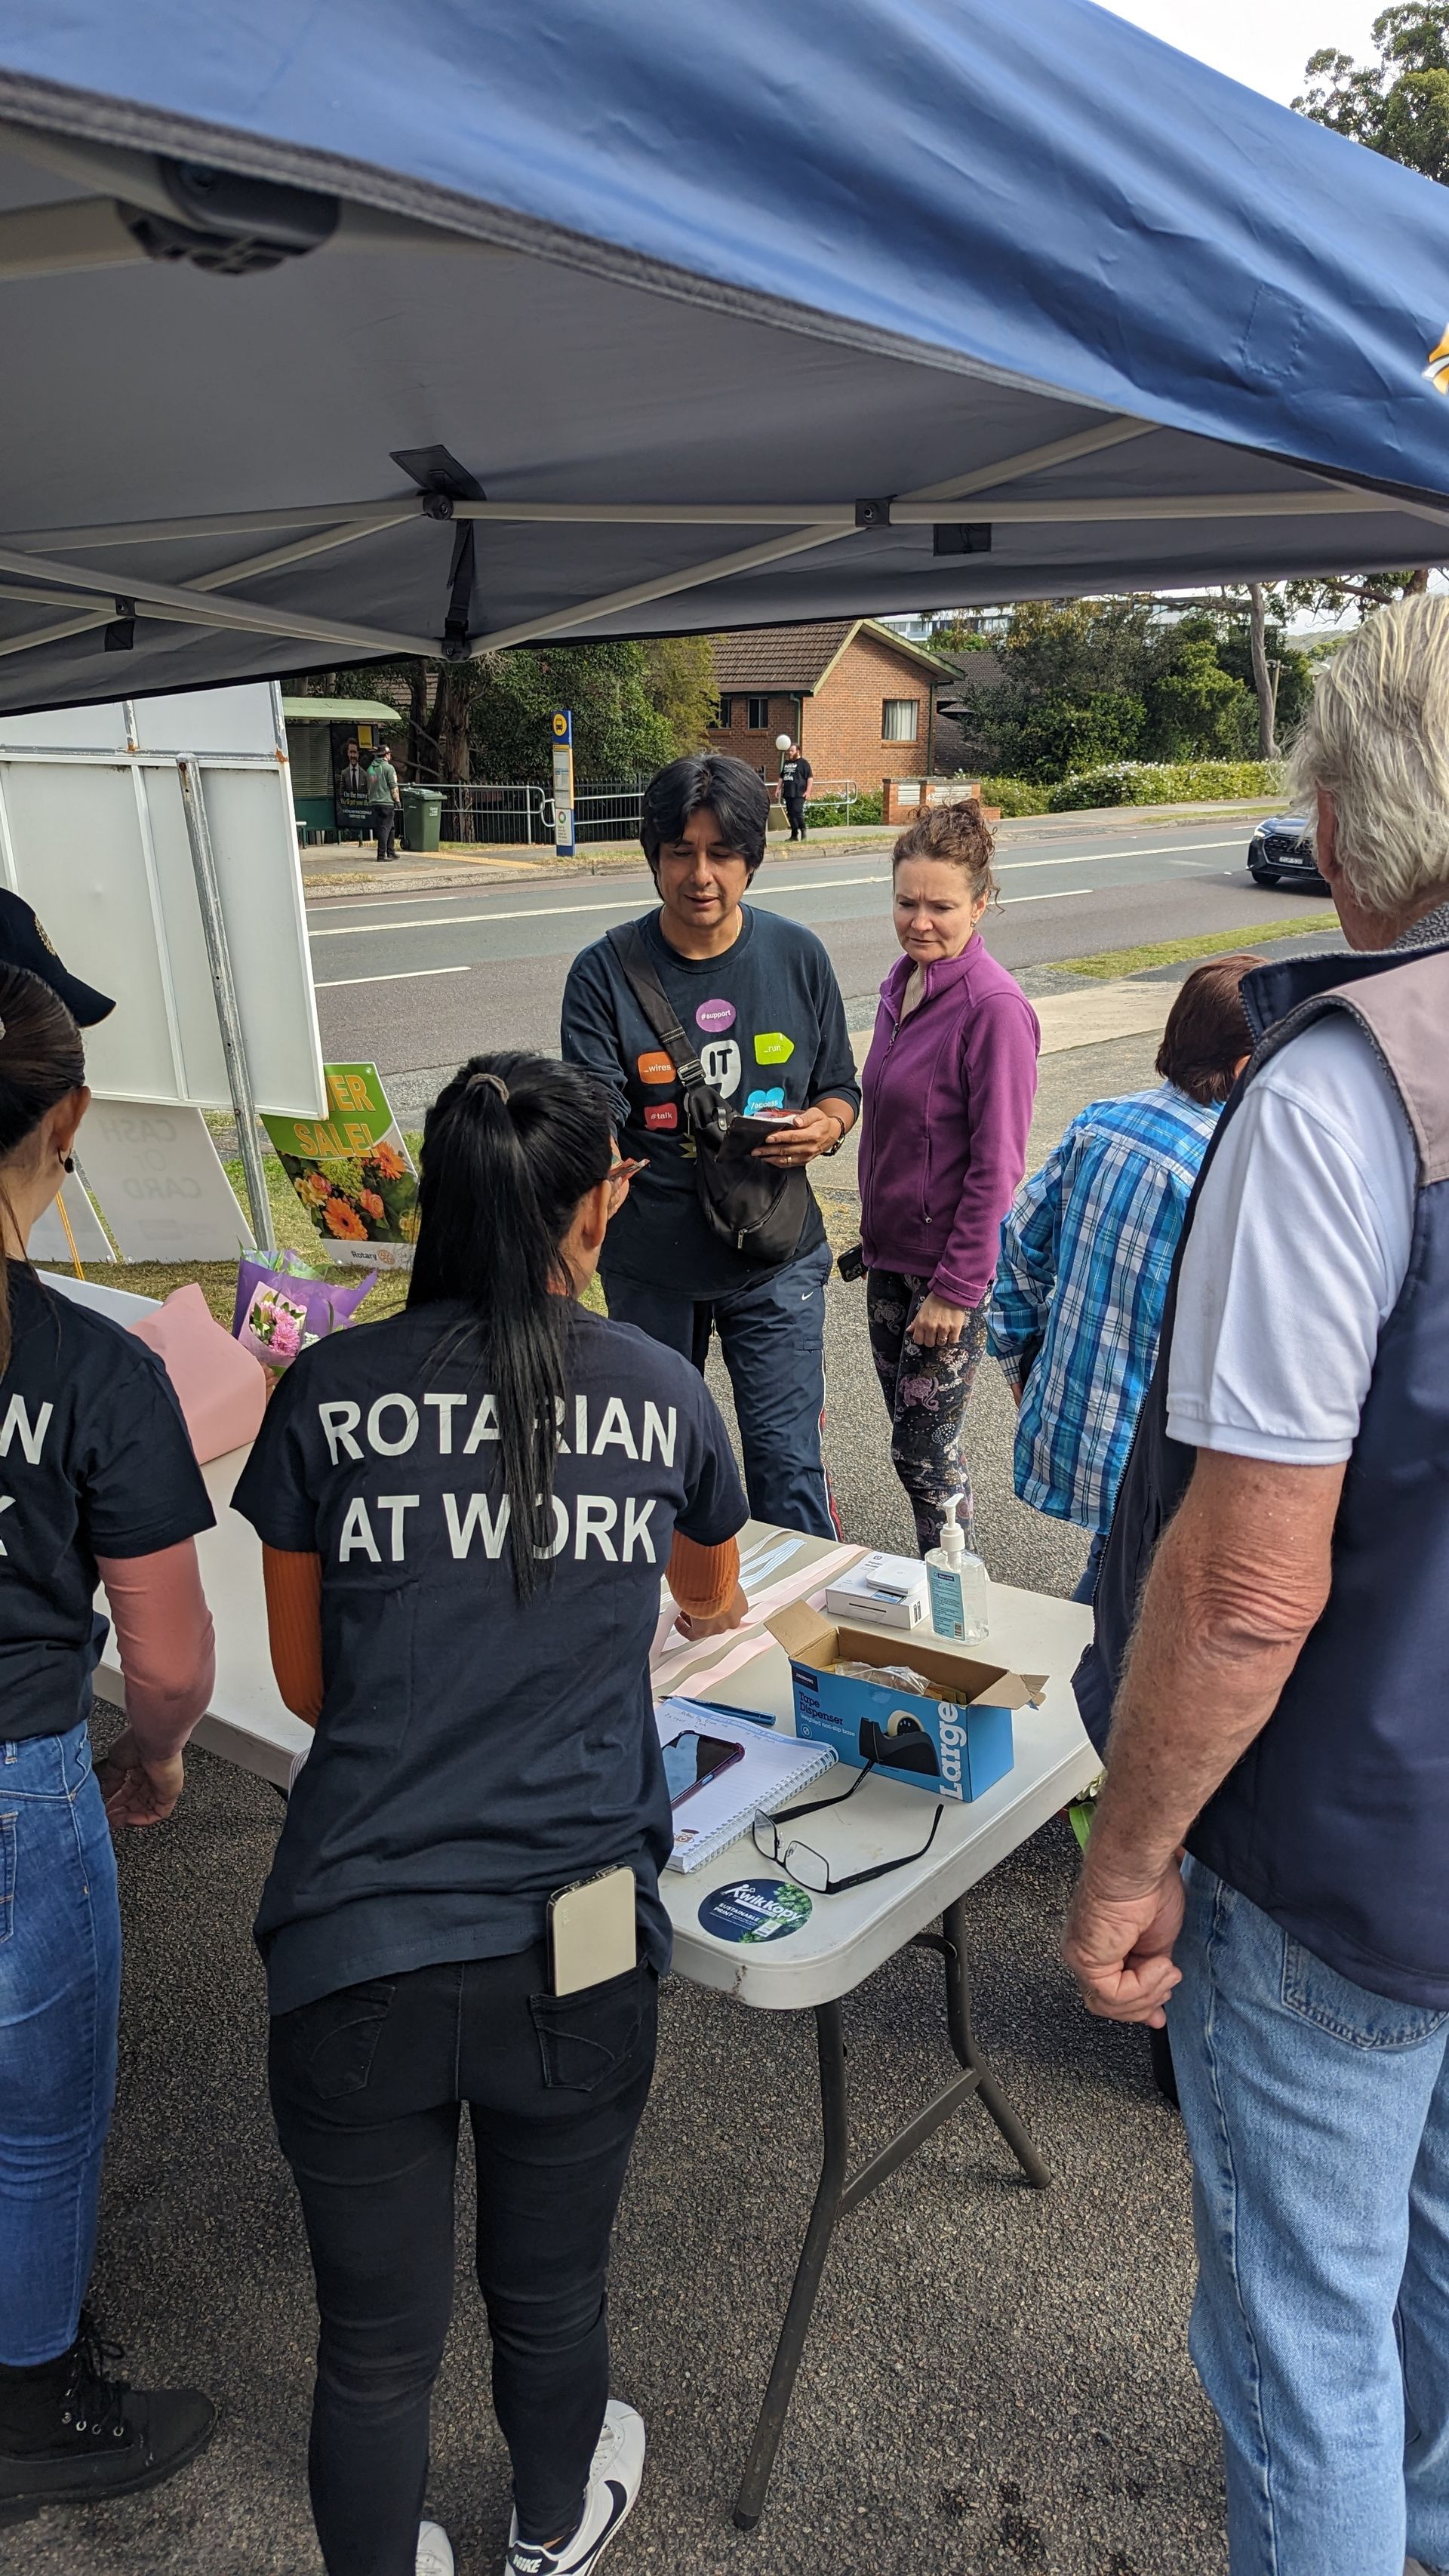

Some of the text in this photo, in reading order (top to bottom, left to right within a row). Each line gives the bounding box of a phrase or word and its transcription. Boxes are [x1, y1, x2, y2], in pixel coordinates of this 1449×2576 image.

[700, 1009, 731, 1021] #support
[764, 1044, 781, 1054] _run
[644, 1063, 672, 1073] _wires
[709, 1048, 733, 1077] IT
[325, 1075, 377, 1112] ER
[751, 1099, 779, 1110] /access
[651, 1111, 673, 1120] #talk
[294, 1123, 380, 1158] SALE!
[351, 1251, 377, 1261] Rotary
[339, 1494, 420, 1562] AT
[799, 1691, 820, 1708] Tape
[800, 1701, 844, 1725] Dispenser
[938, 1701, 968, 1800] Large
[713, 1907, 734, 1917] PRINT
[513, 2554, 543, 2574] NIKE
